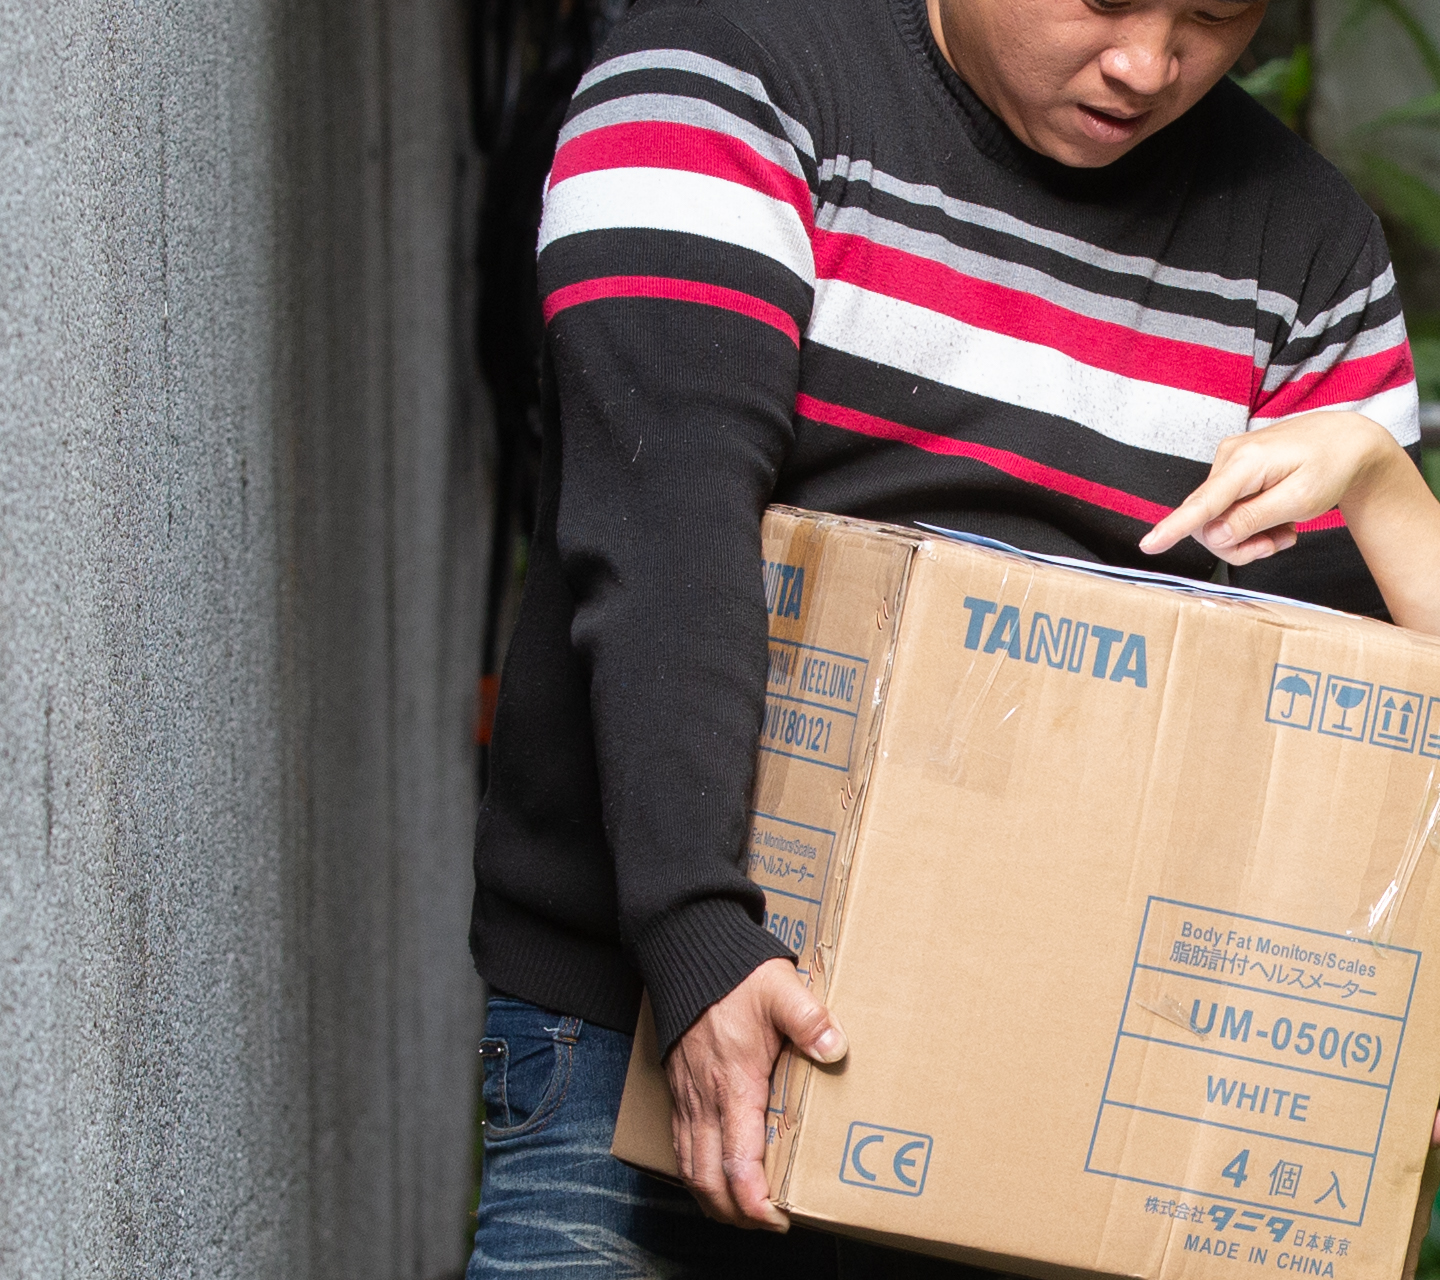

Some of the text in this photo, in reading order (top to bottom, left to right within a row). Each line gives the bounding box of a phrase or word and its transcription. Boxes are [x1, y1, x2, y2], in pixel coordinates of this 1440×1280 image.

[963, 596, 1148, 689] TANITA
[800, 656, 857, 702] KEELUNG
[1169, 940, 1377, 999] 脂肪計付ヘルスメーター
[1181, 921, 1377, 978] Body Fat Monitors/Scales
[1189, 999, 1383, 1073] UM-050(S)
[1207, 1075, 1311, 1122] WHITE
[1183, 1234, 1335, 1279] MADE IN CHINA
